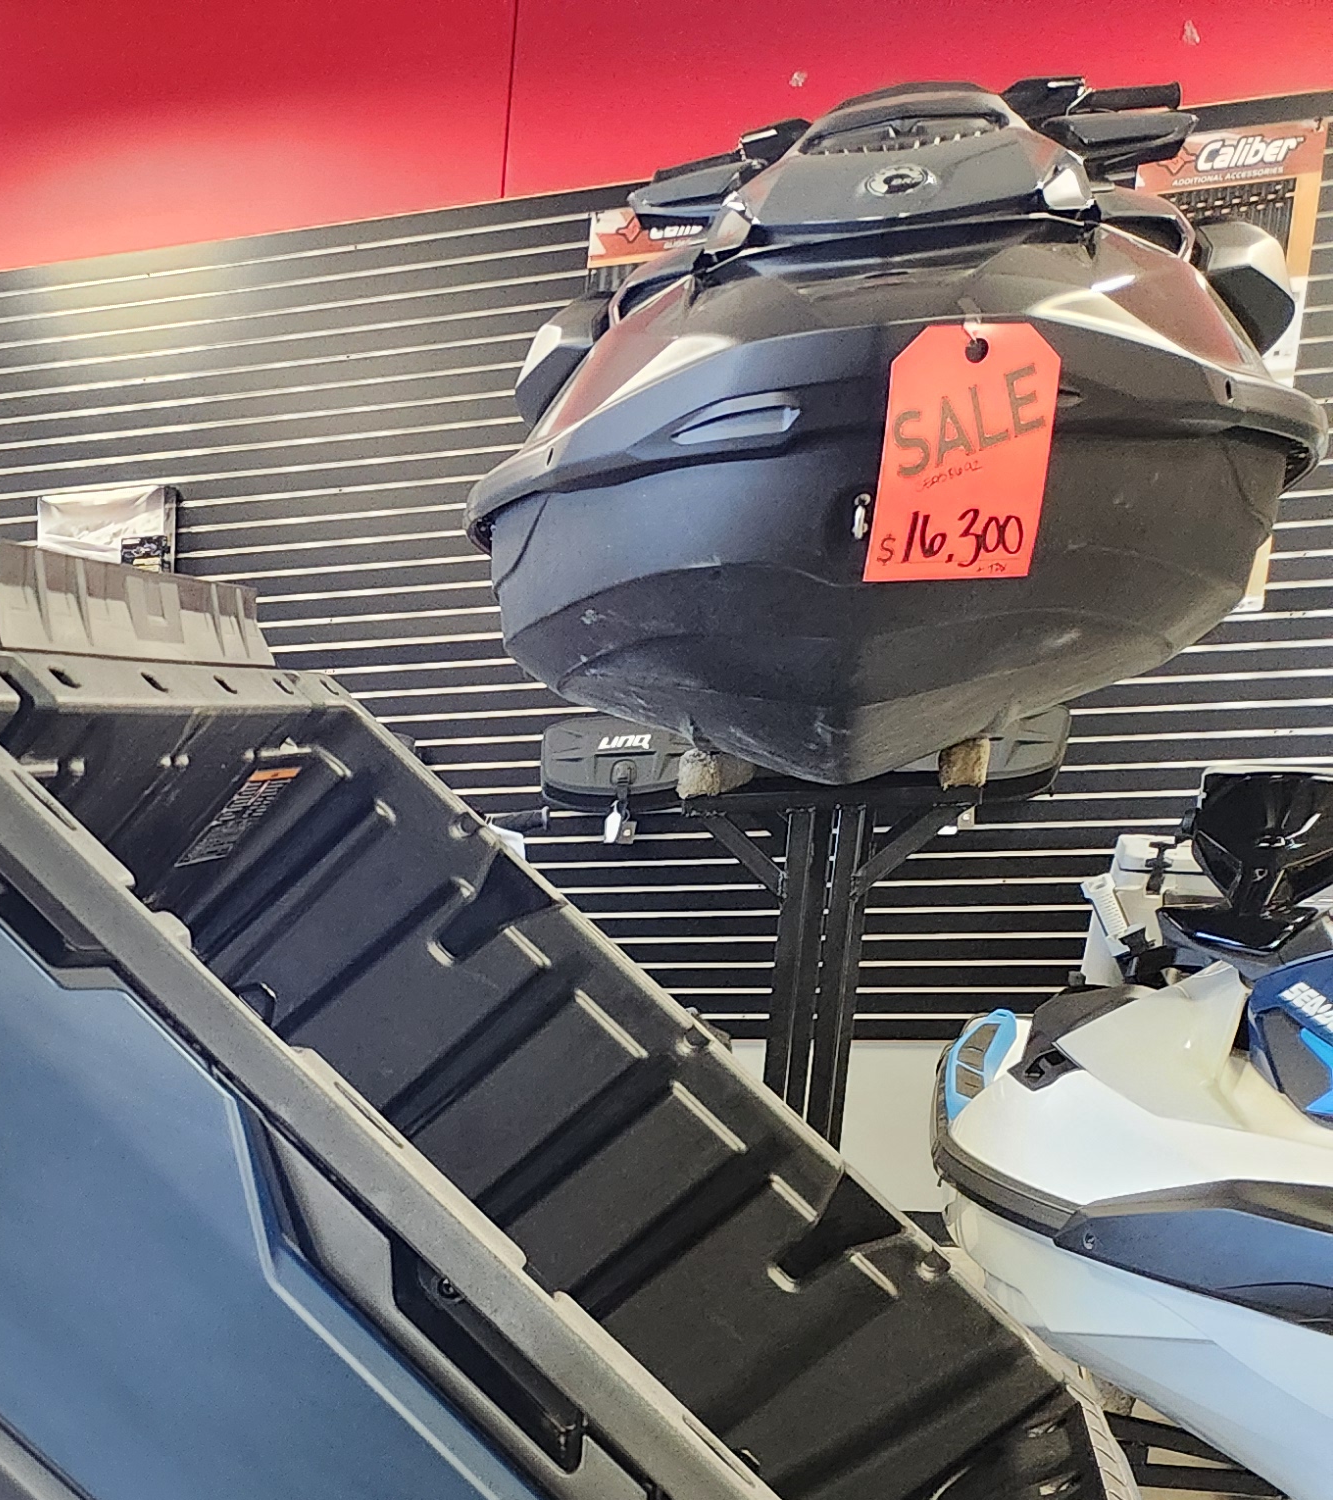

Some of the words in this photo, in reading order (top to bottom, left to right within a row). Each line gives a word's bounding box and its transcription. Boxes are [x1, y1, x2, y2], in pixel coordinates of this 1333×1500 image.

[1195, 135, 1297, 172] Caliber
[1172, 174, 1223, 187] ADDITIONAL
[1224, 166, 1284, 181] ACCESSORIES
[893, 363, 1047, 477] SALE
